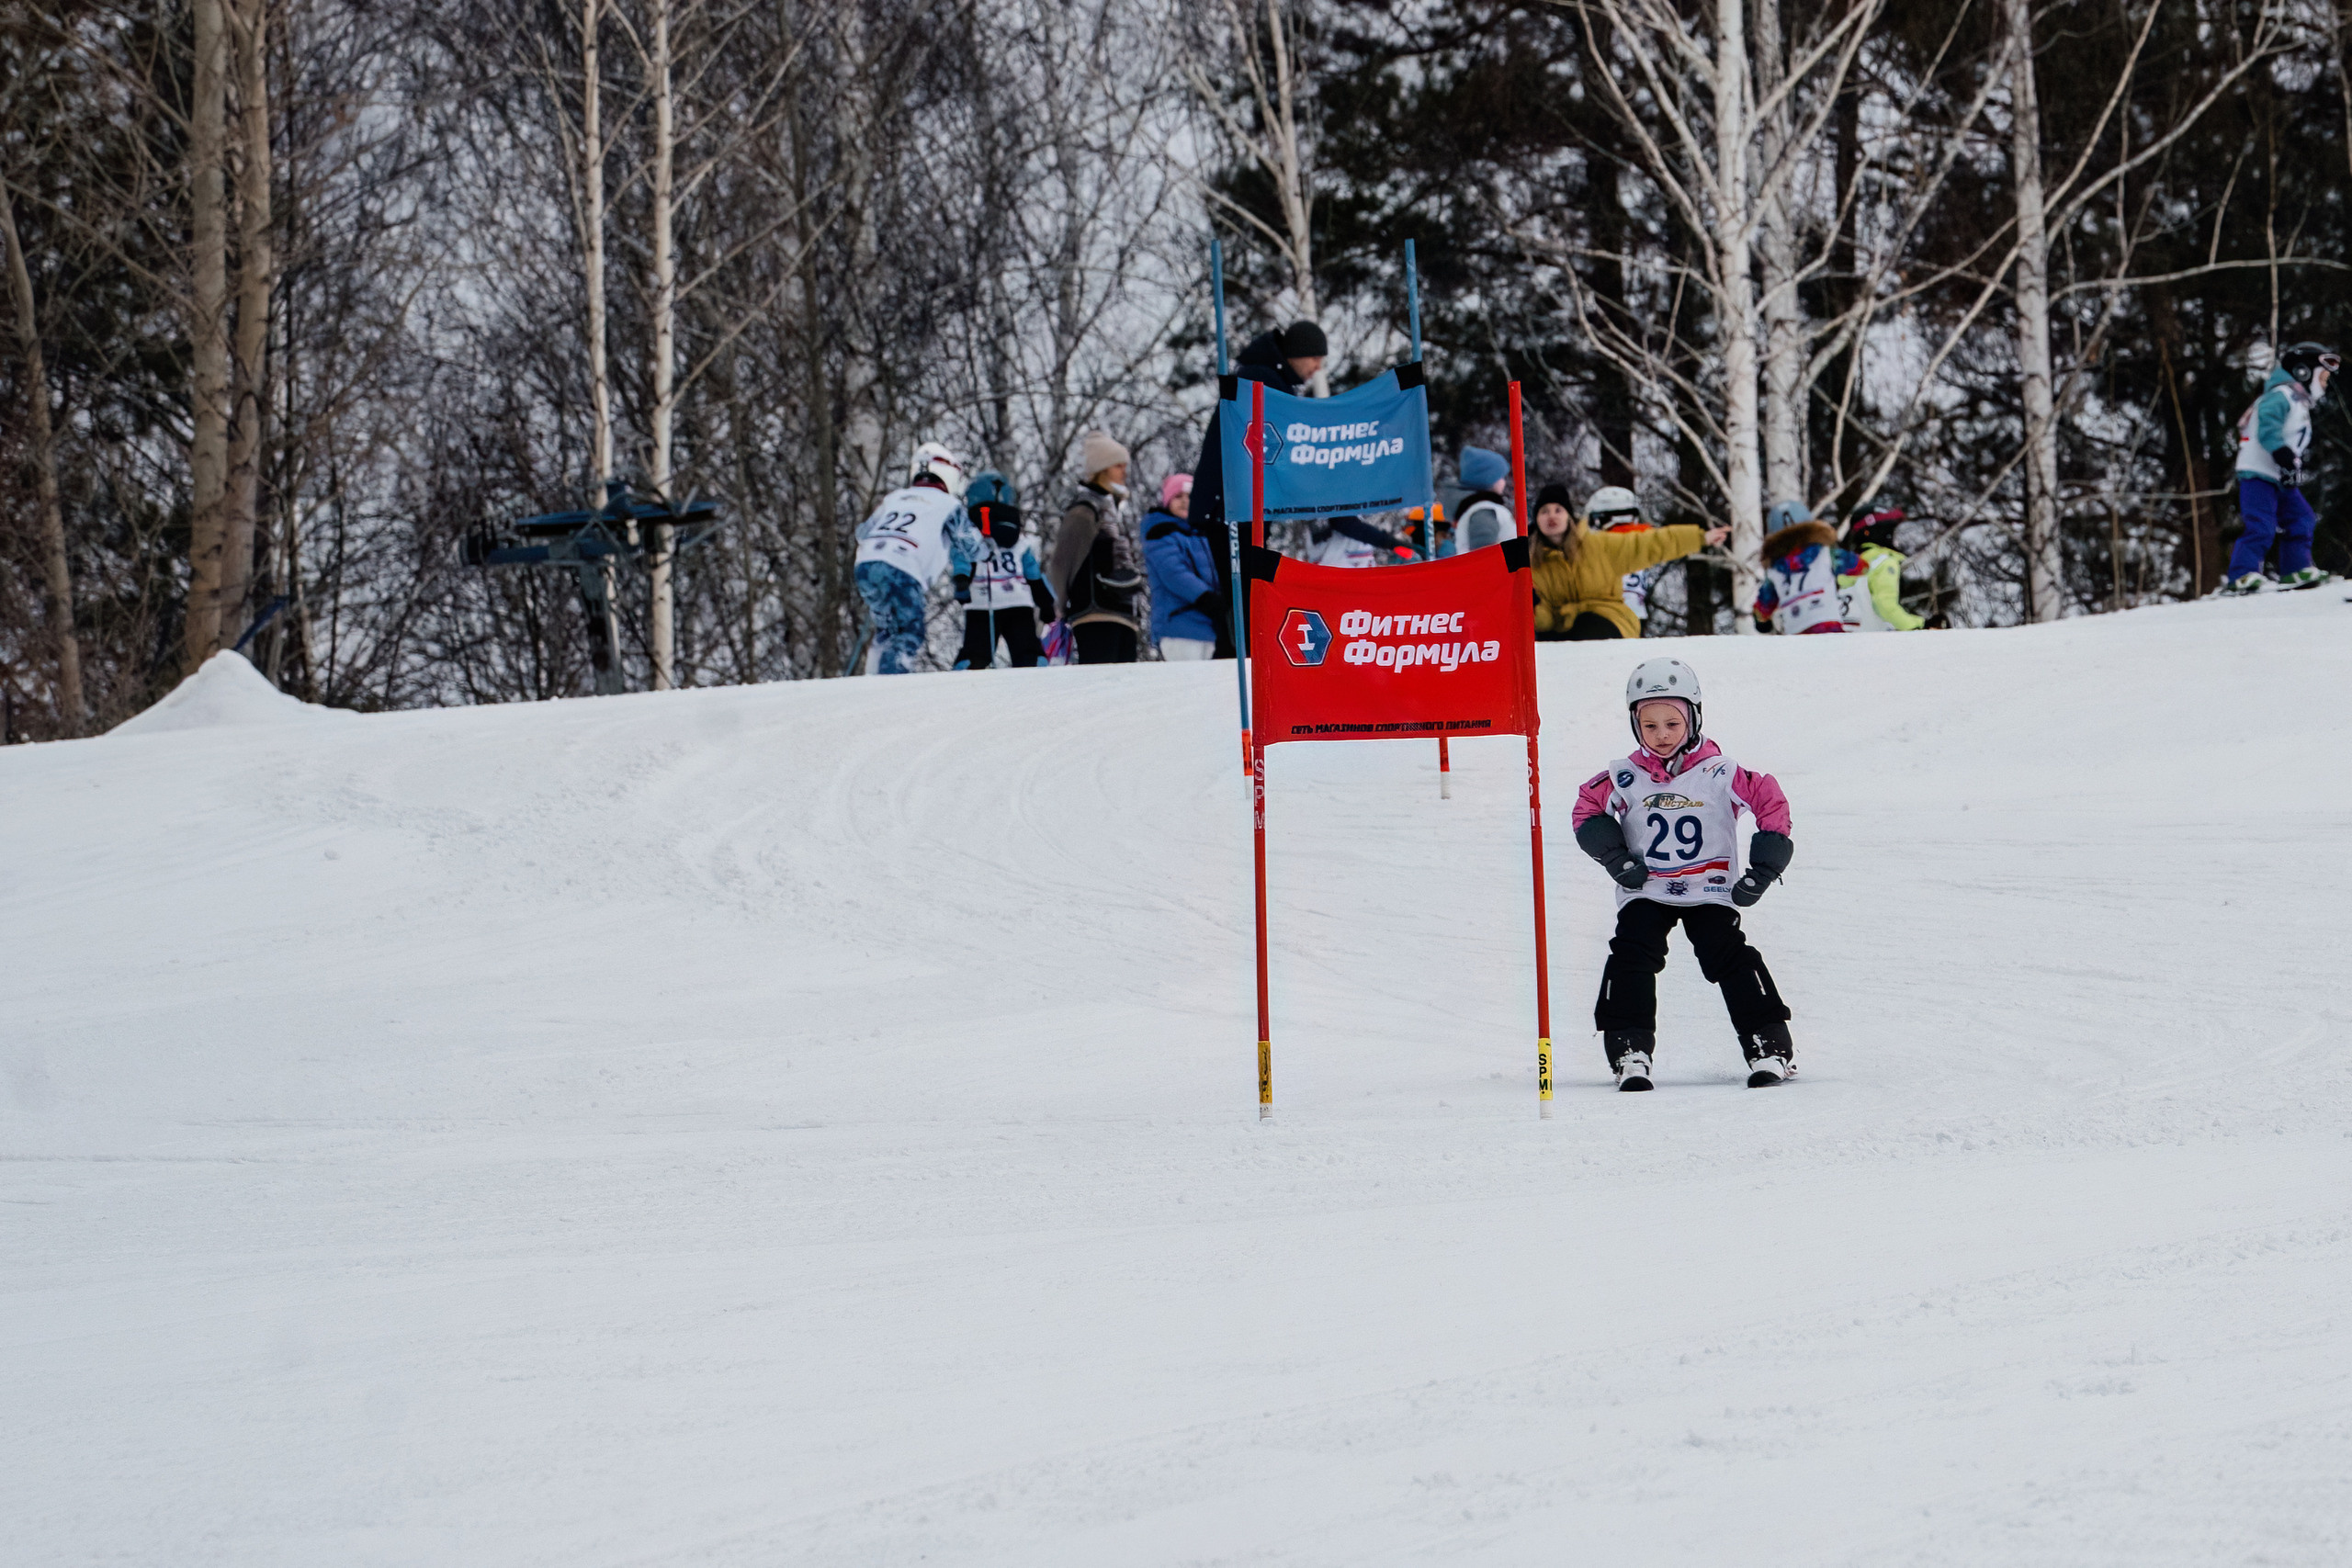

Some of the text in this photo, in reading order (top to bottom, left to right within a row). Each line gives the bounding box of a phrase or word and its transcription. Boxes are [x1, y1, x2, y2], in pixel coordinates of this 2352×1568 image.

[1286, 420, 1379, 443] Фитнес
[1290, 437, 1404, 469] Формула
[877, 512, 916, 533] 22
[992, 551, 1016, 573] 18
[1340, 610, 1465, 637] Фитнес
[1343, 639, 1500, 673] Формула
[1291, 725, 1313, 734] СЕТЬ
[1316, 723, 1374, 733] МАГАЗИНОВ
[1445, 719, 1491, 730] ПИТАНИЯ
[1645, 813, 1703, 861] 29
